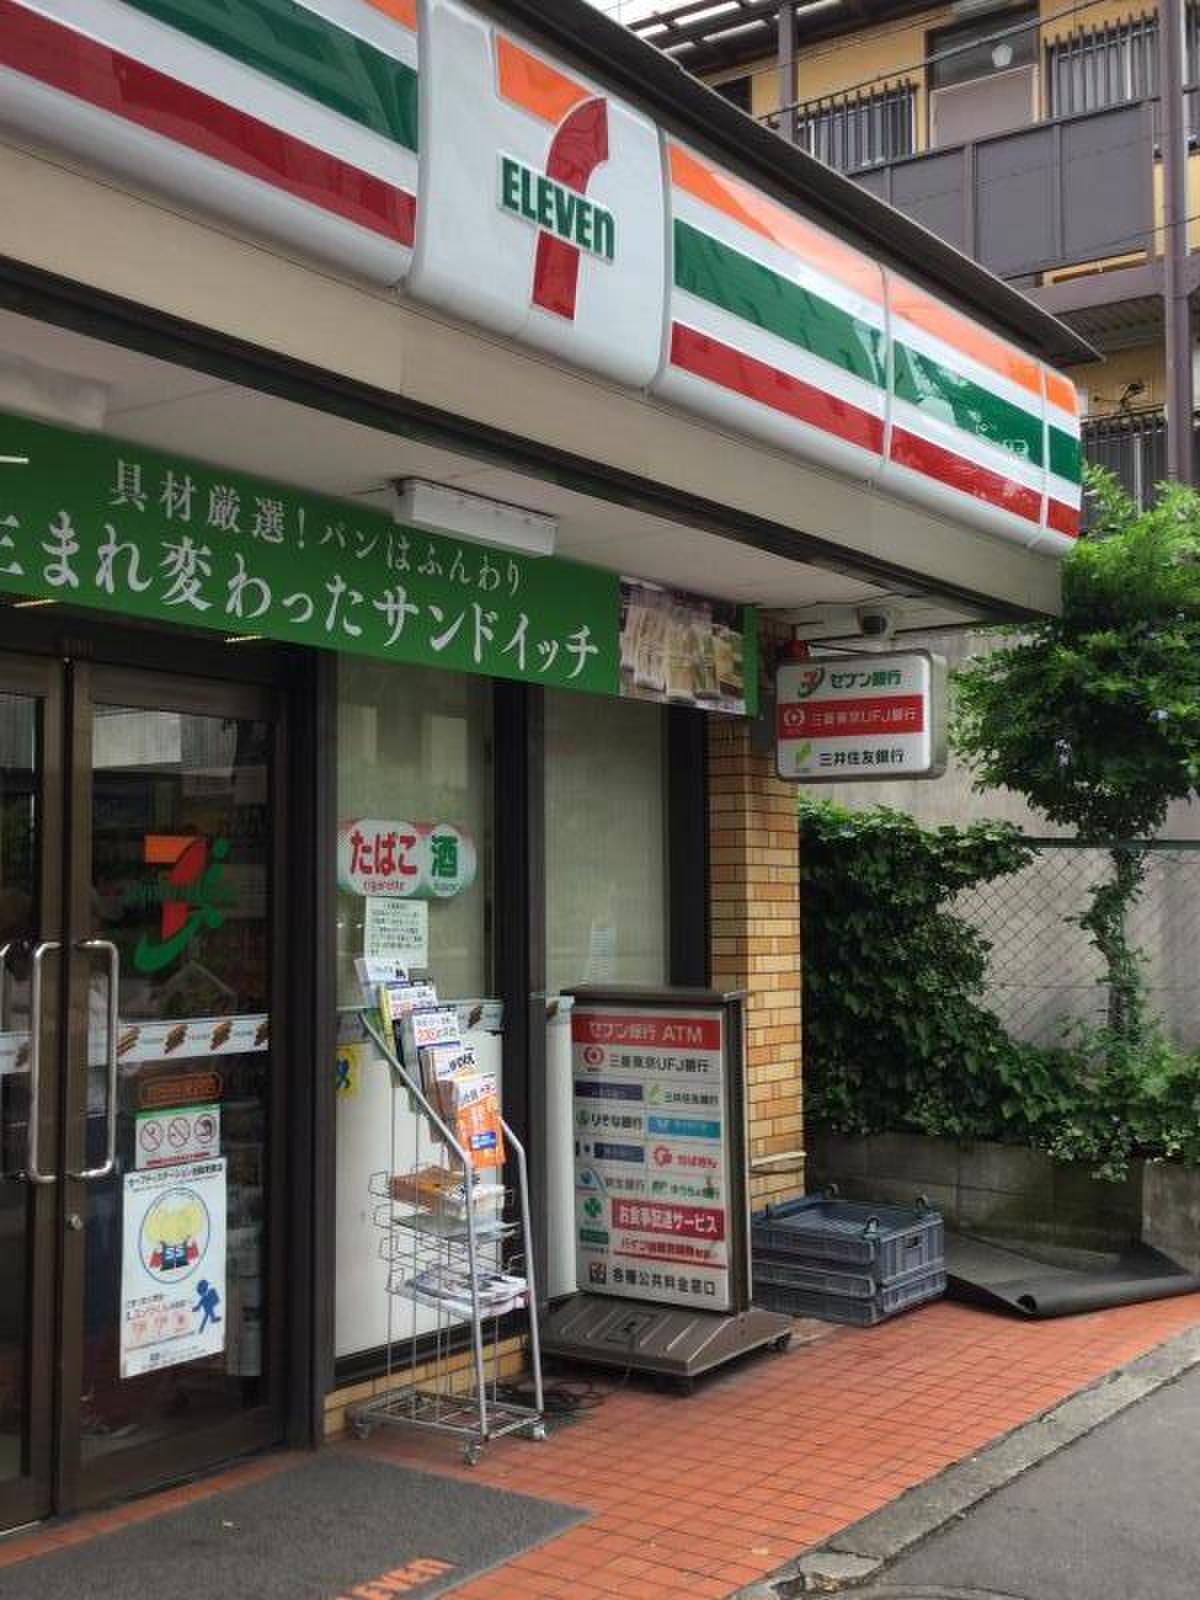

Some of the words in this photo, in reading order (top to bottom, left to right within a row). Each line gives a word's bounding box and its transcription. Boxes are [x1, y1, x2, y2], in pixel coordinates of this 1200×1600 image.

[831, 668, 903, 689] セブン銀行
[819, 748, 904, 766] 三井住友銀行
[350, 829, 418, 877] たばこ
[431, 835, 459, 878] 酒
[589, 1022, 657, 1041] セブン銀行
[662, 1024, 704, 1044] ATM
